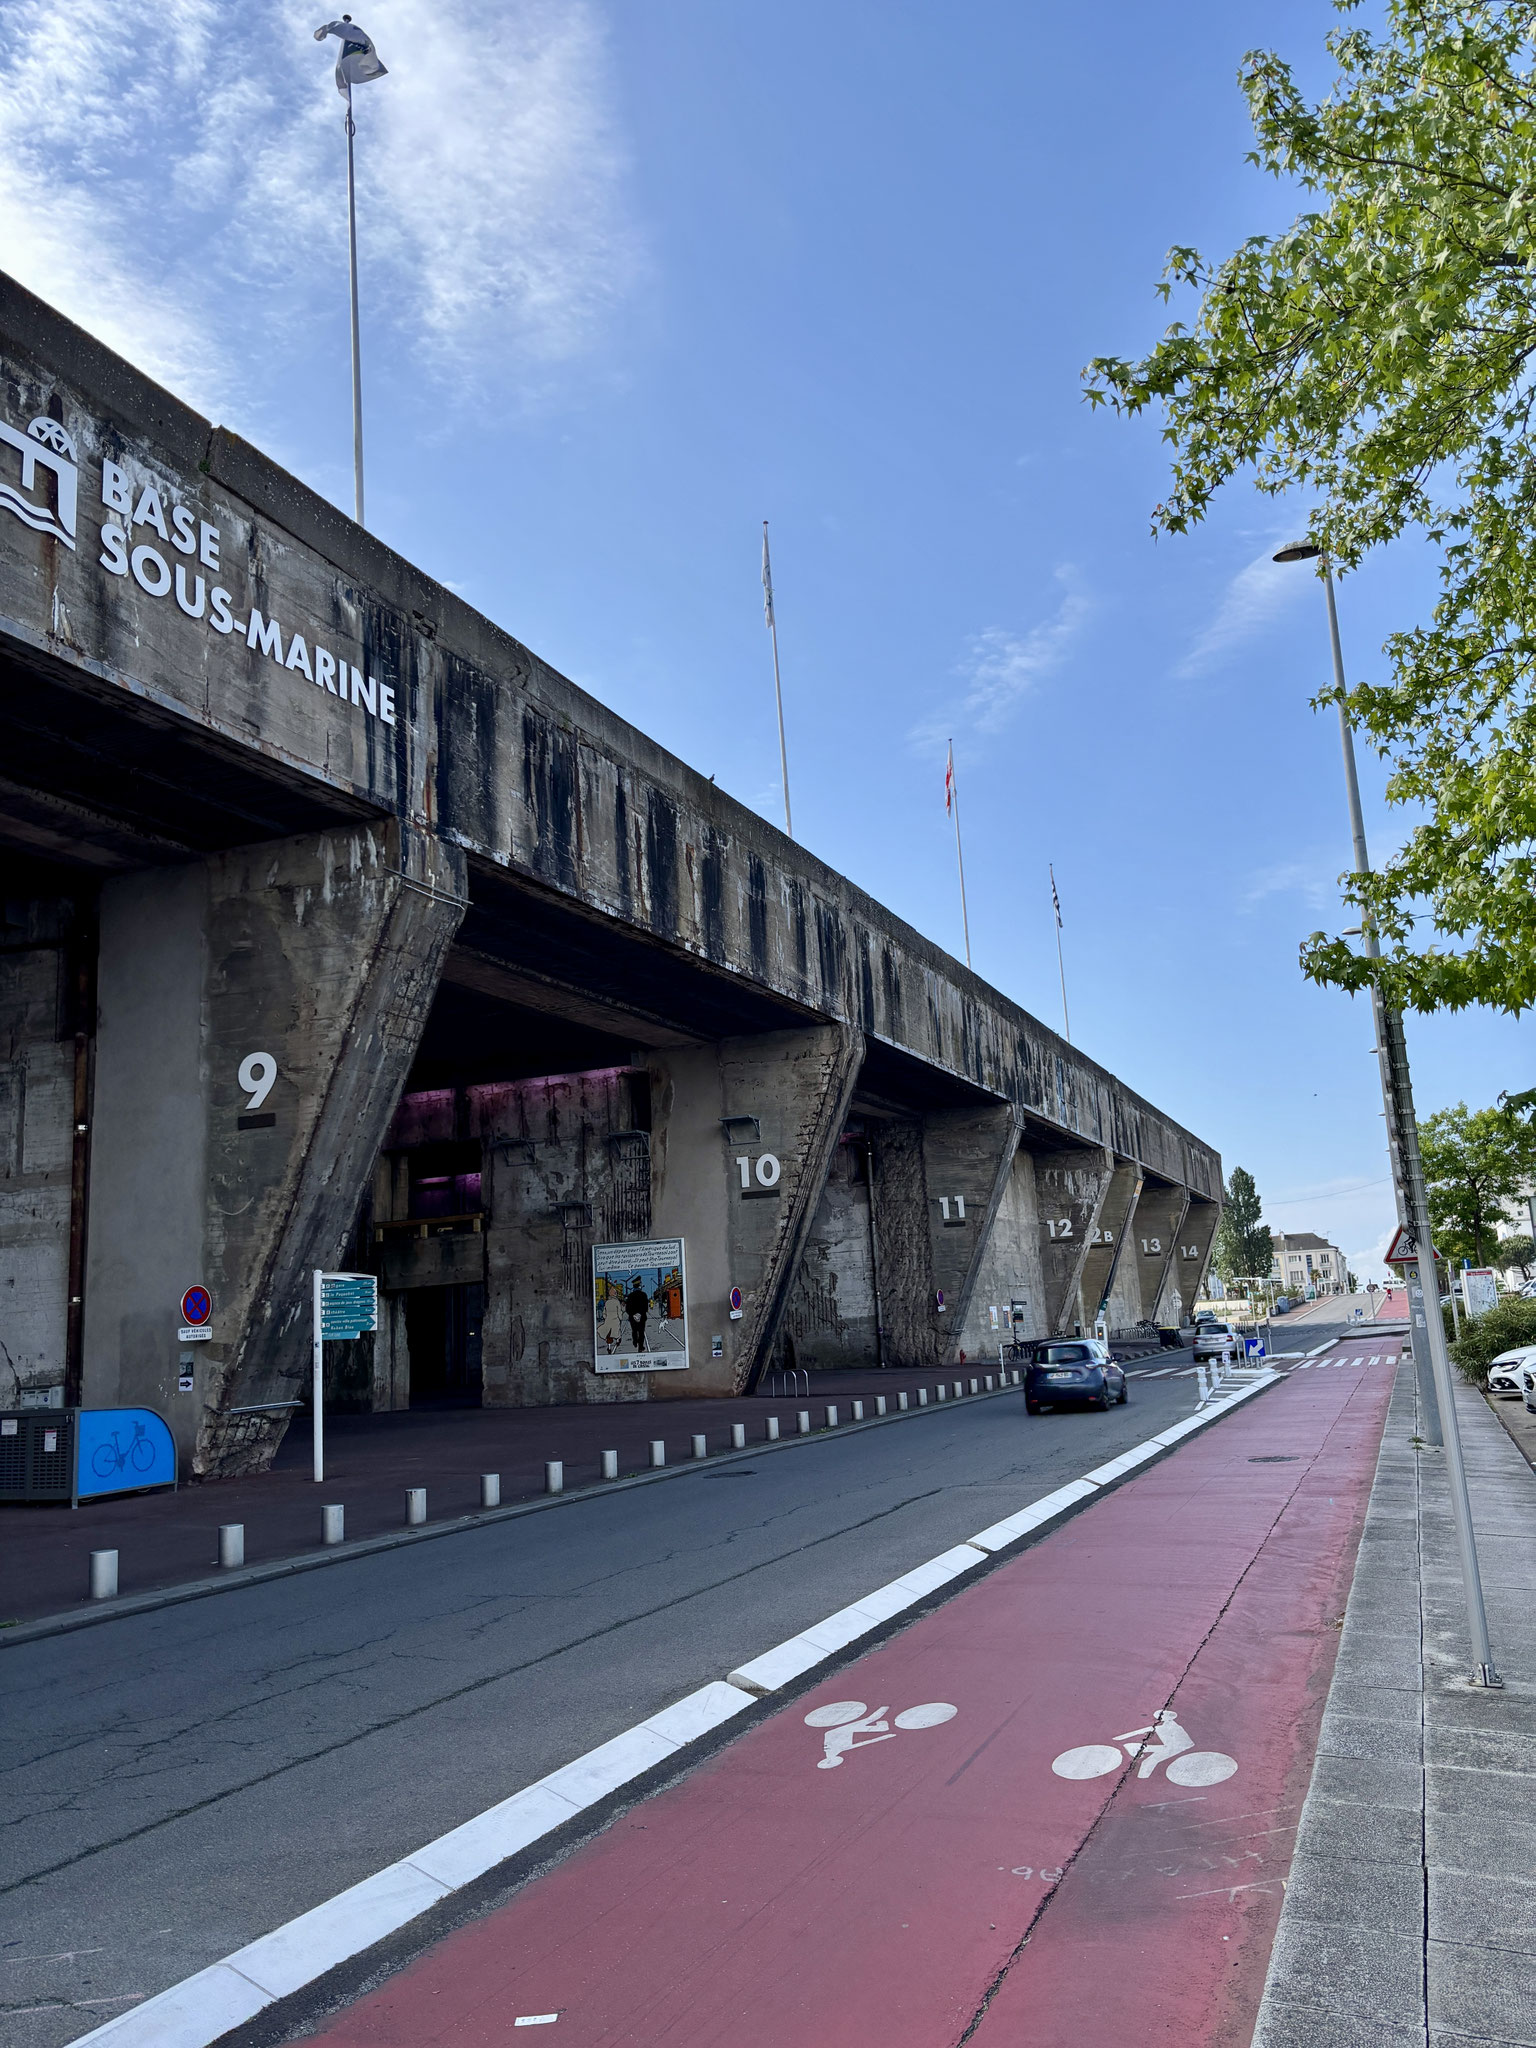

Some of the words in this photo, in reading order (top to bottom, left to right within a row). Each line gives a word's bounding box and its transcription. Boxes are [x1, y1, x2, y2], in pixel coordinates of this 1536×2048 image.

[102, 457, 220, 572] BASE
[100, 522, 396, 726] SOUS-MARINE
[238, 1051, 277, 1109] 9
[736, 1153, 780, 1188] 10
[938, 1195, 965, 1219] 11
[1046, 1218, 1073, 1237] 12
[1091, 1226, 1114, 1242] 2B
[1141, 1238, 1161, 1252] 13
[1180, 1245, 1199, 1257] 14
